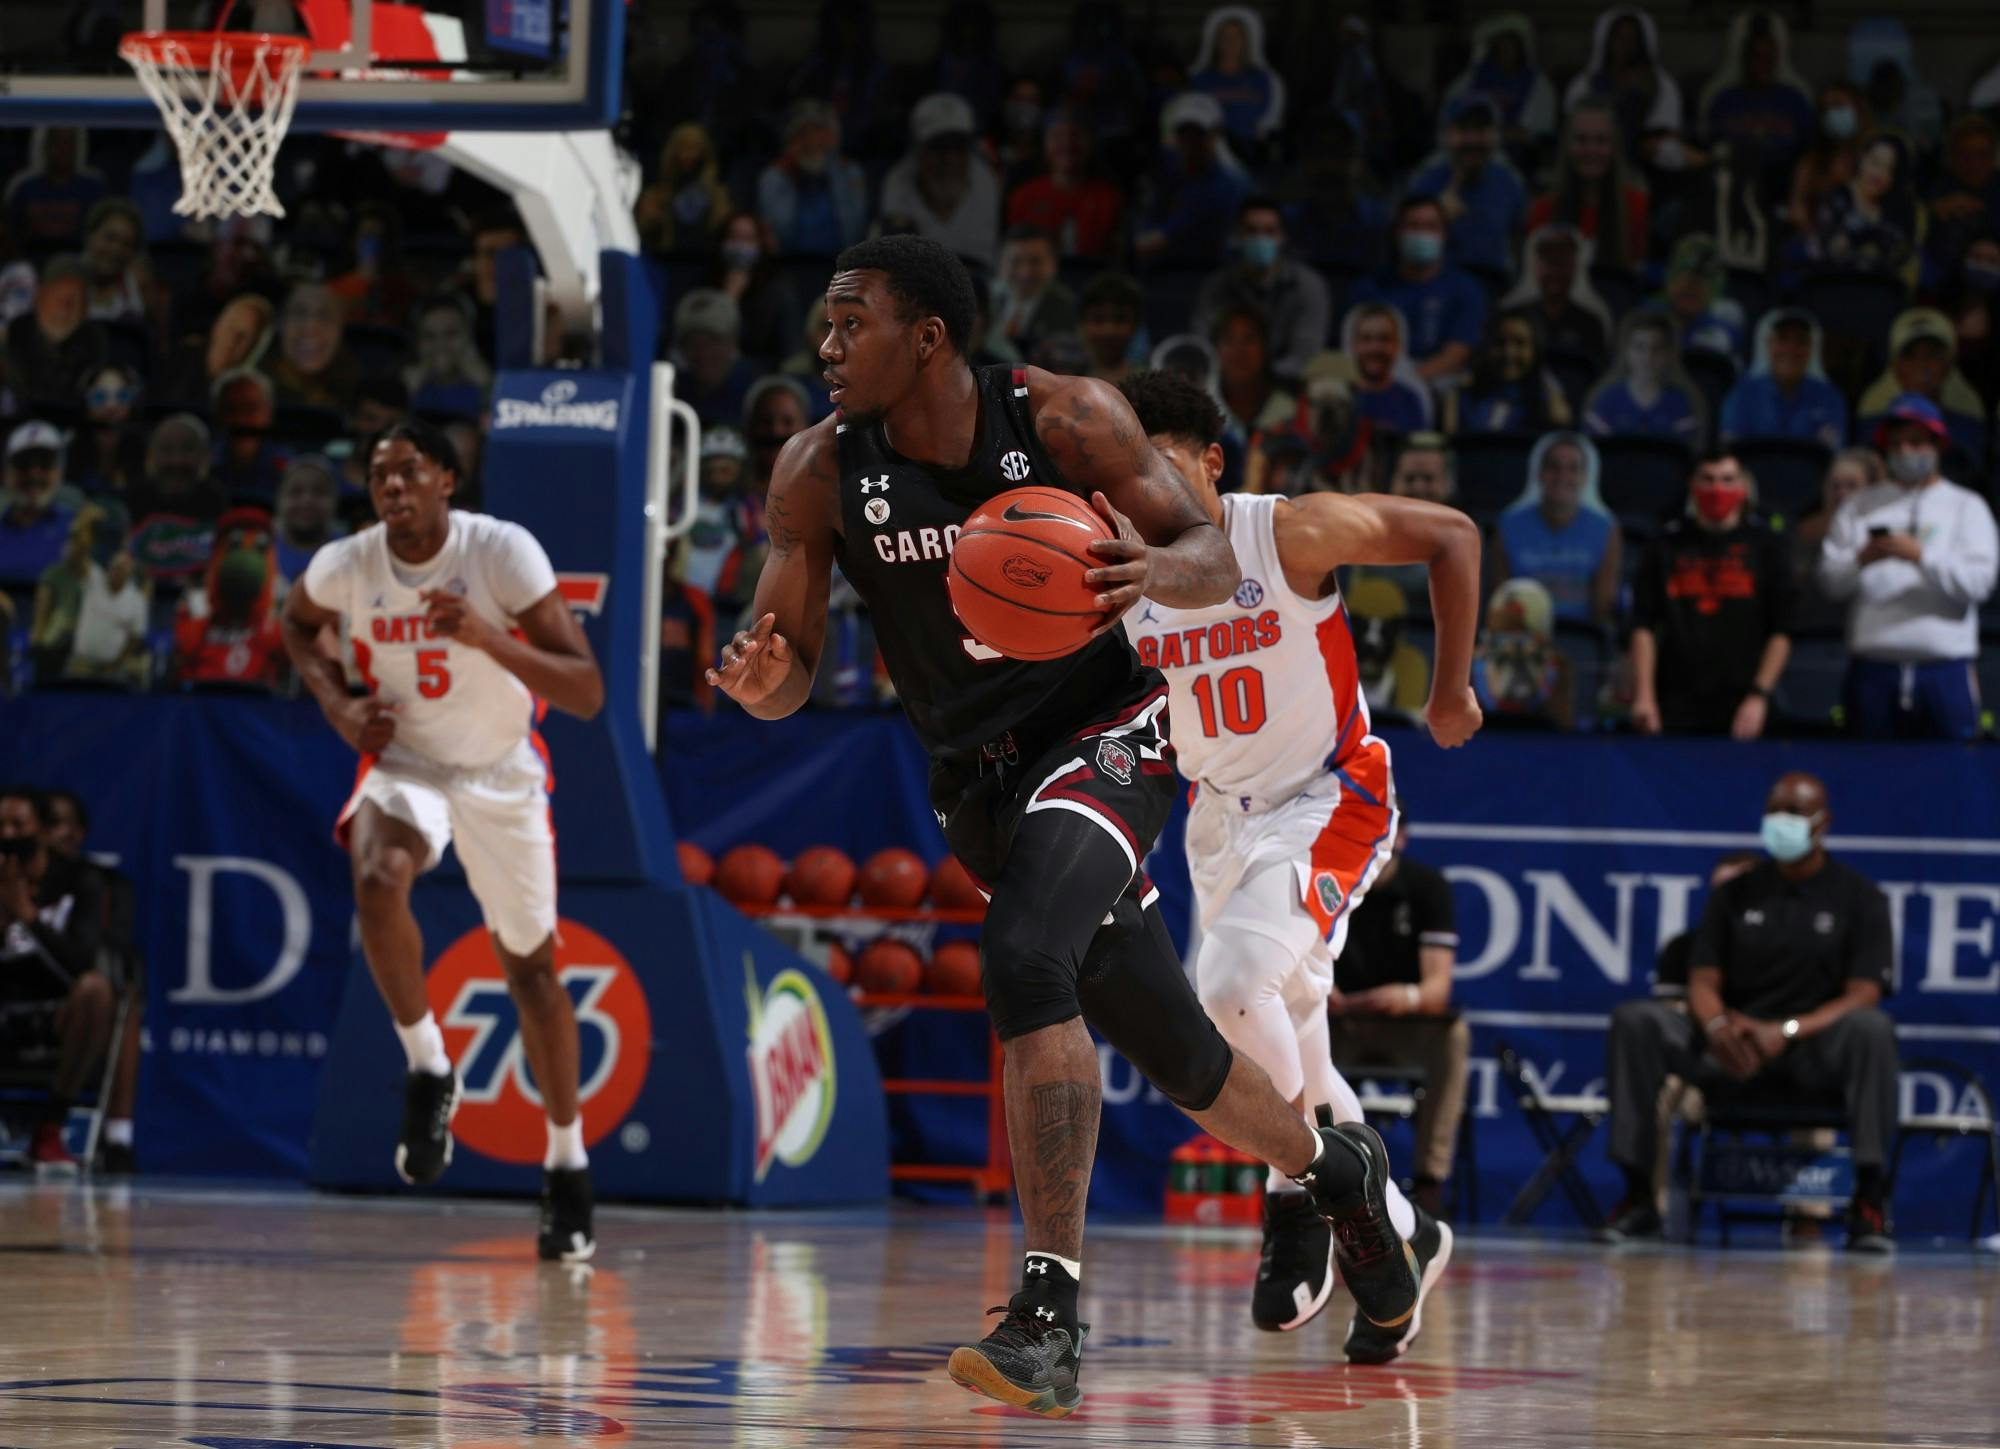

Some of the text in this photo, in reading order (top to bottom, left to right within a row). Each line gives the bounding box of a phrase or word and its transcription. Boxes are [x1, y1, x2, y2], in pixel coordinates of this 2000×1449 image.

[494, 398, 620, 432] SPALDING
[999, 450, 1031, 482] SEC
[873, 523, 962, 564] CARO
[1235, 580, 1264, 609] SEC
[371, 615, 434, 643] GATO
[1137, 610, 1282, 670] GATORS
[416, 648, 452, 699] 5
[1192, 665, 1268, 739] 10
[168, 1026, 329, 1060] DIAMOND
